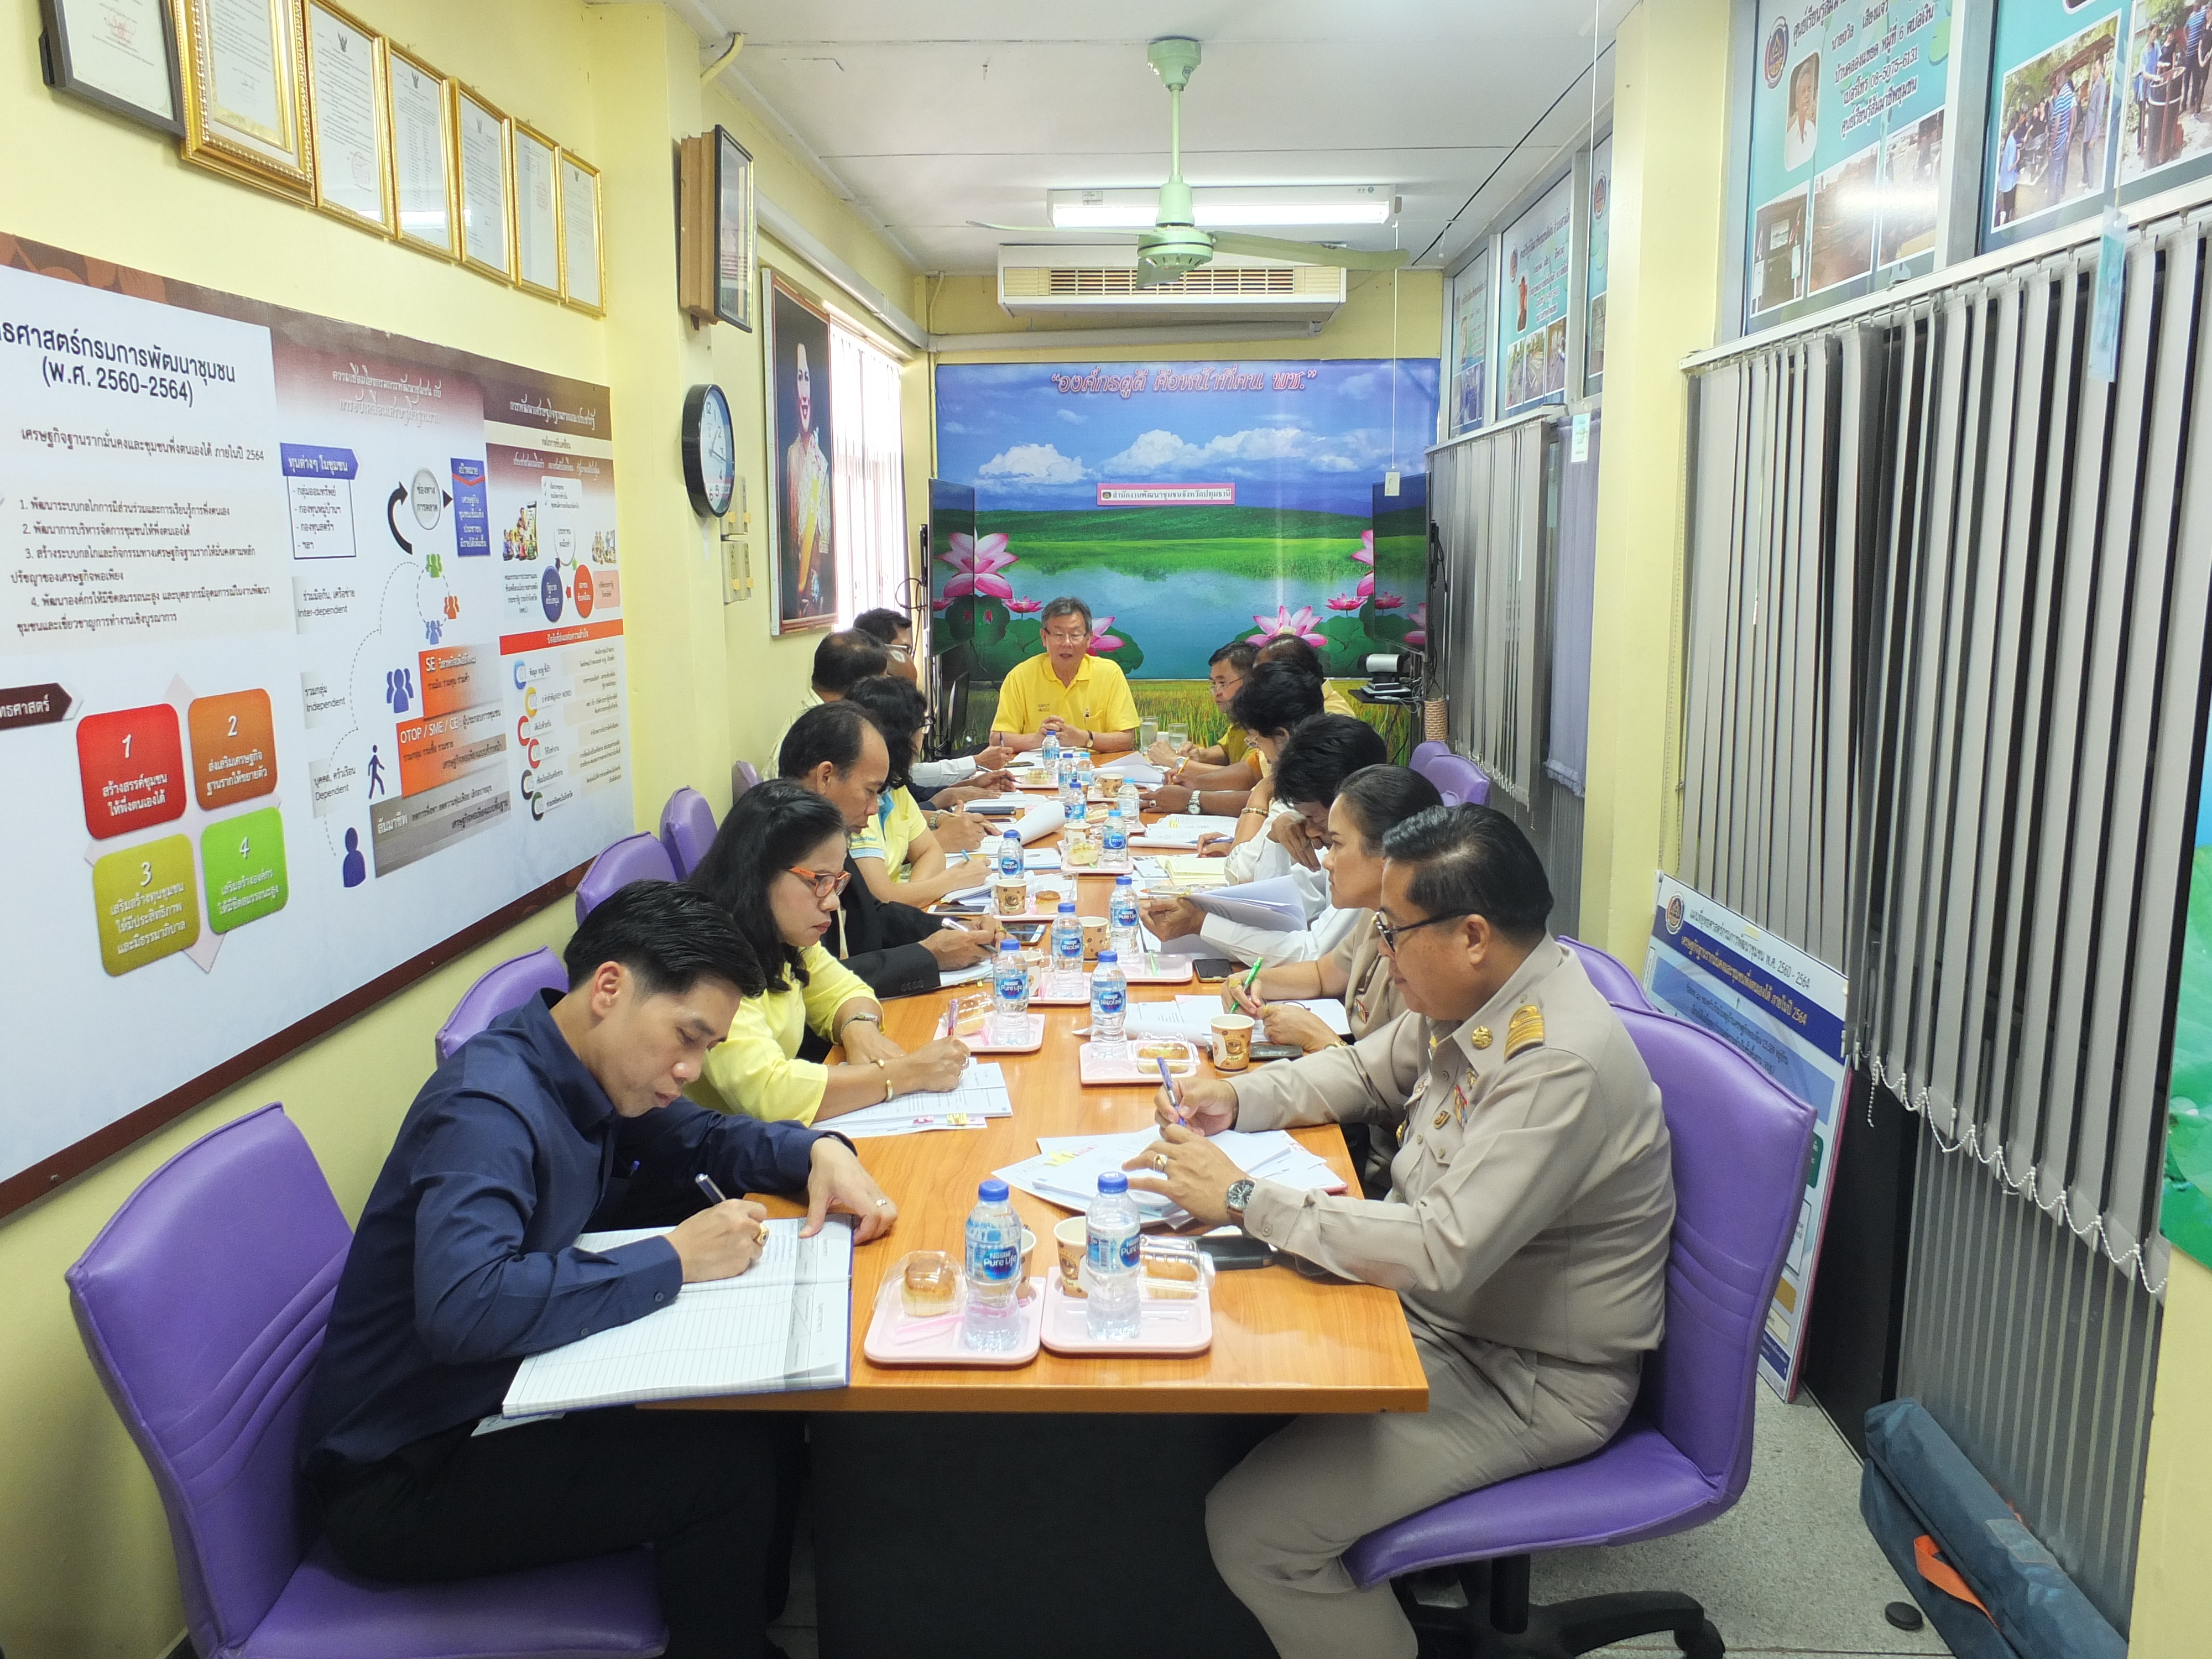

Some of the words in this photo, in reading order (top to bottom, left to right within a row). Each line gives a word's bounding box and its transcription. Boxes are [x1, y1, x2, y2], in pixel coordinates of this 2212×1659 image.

[1899, 25, 1904, 40] 6
[0, 322, 236, 386] ธศาสตร์กรมการพัฒนาชุมชน
[43, 356, 91, 388] (พ.ศ.
[97, 367, 193, 408] 2560-2564)
[215, 445, 244, 460] ภายในปี
[246, 449, 265, 461] 2564
[426, 656, 436, 672] SE
[306, 697, 346, 713] Independent
[228, 715, 238, 737] 2
[400, 727, 422, 744] OTOP
[429, 721, 444, 737] SME
[122, 733, 133, 759] 1
[102, 773, 168, 797] สร้างสรรค์ชุมชน
[315, 784, 349, 801] Dependent
[107, 789, 166, 817] ให้พึ่งตนเองได้
[239, 836, 251, 859] 4
[140, 861, 152, 887] 3
[1776, 959, 1791, 978] 2560
[1795, 971, 1811, 989] 2564
[1792, 1006, 1808, 1025] 2564
[983, 1258, 1004, 1267] Pure
[1005, 1254, 1017, 1267] Life
